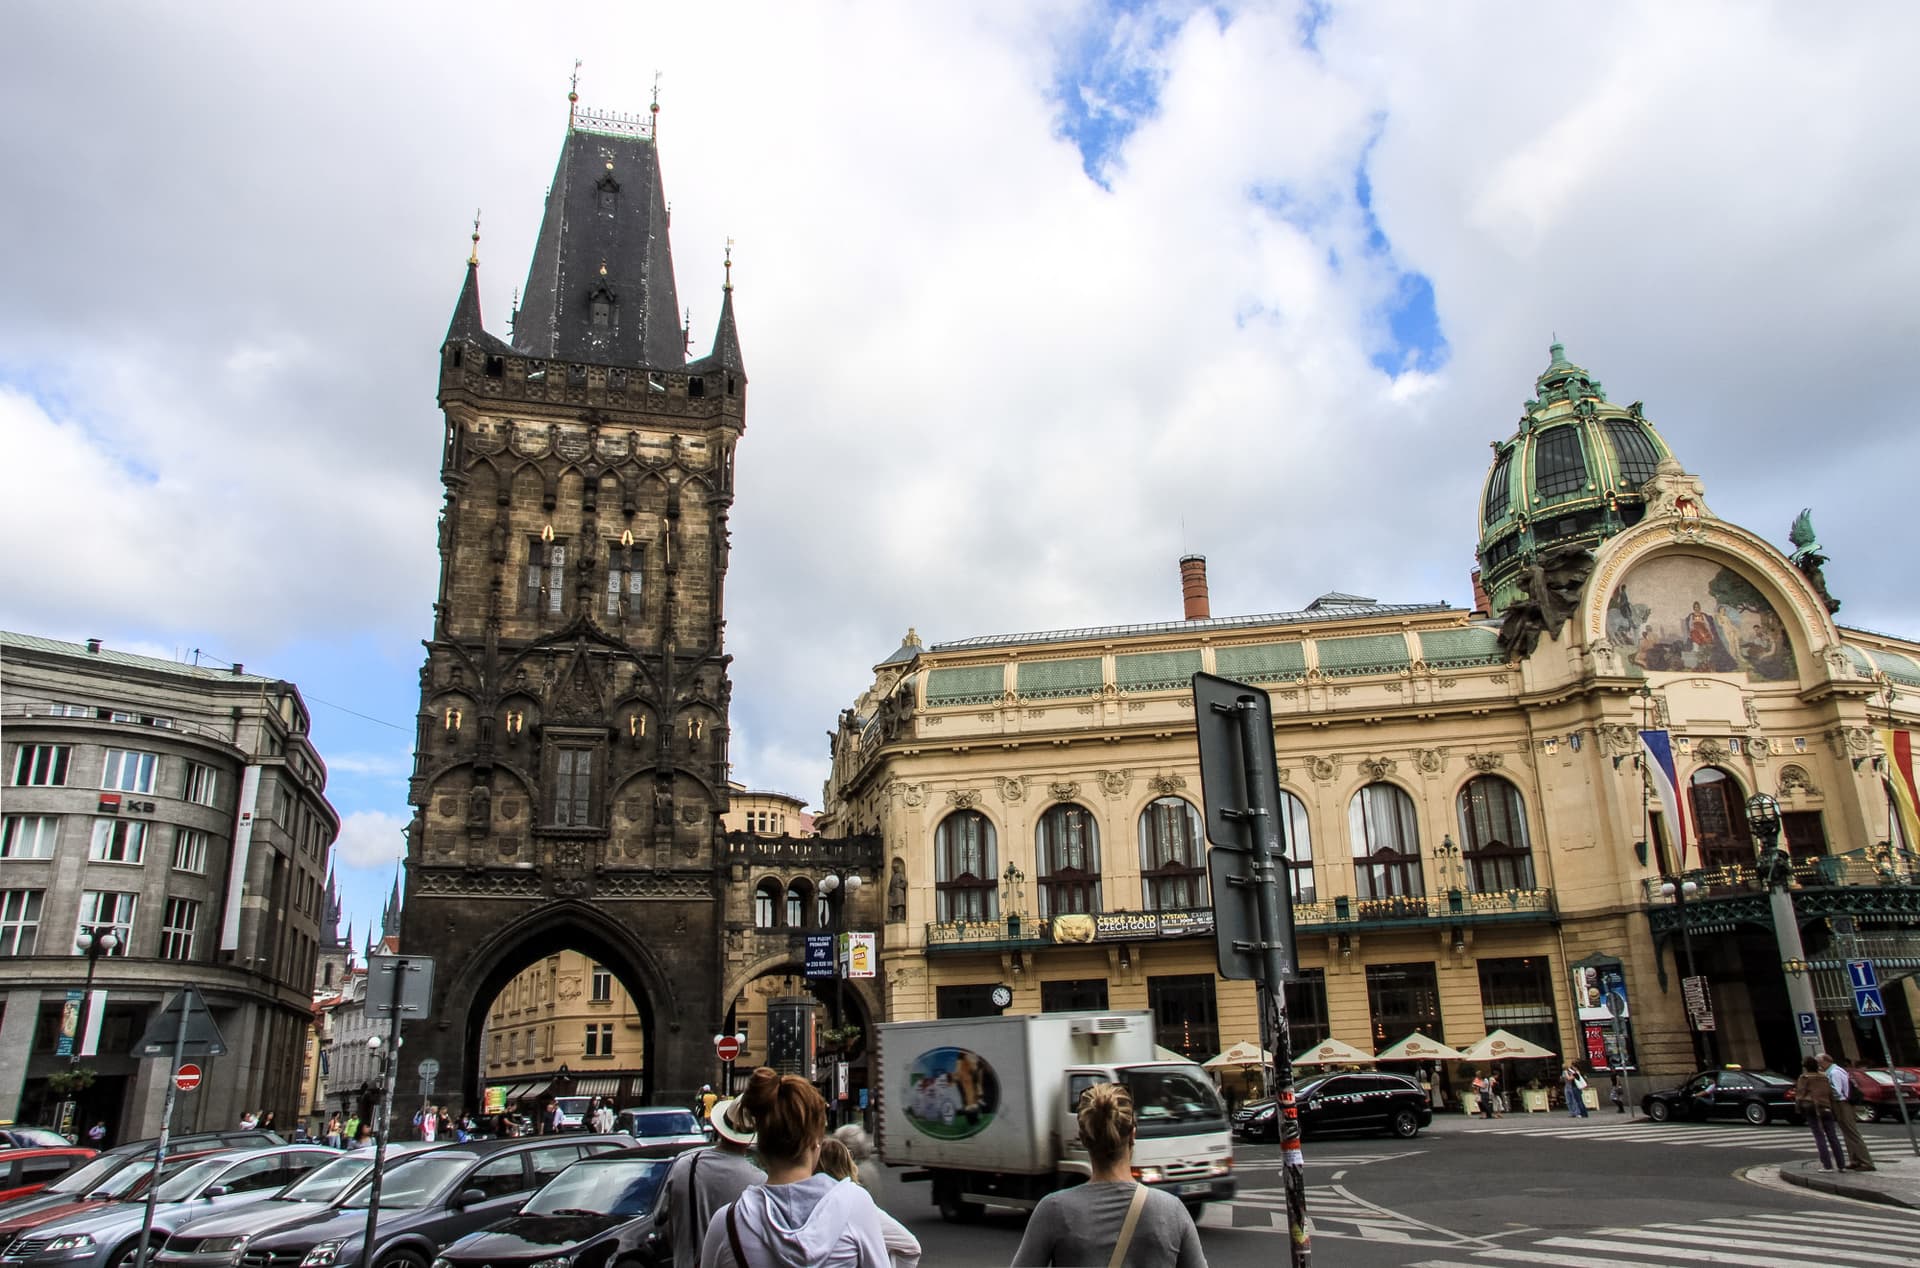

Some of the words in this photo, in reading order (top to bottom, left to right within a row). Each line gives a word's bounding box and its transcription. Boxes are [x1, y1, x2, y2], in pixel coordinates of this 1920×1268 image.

[127, 800, 156, 813] KB
[1127, 914, 1156, 924] ZLATO
[1097, 923, 1129, 932] CZECH
[1130, 921, 1156, 931] GOLD
[1801, 1015, 1811, 1028] P
